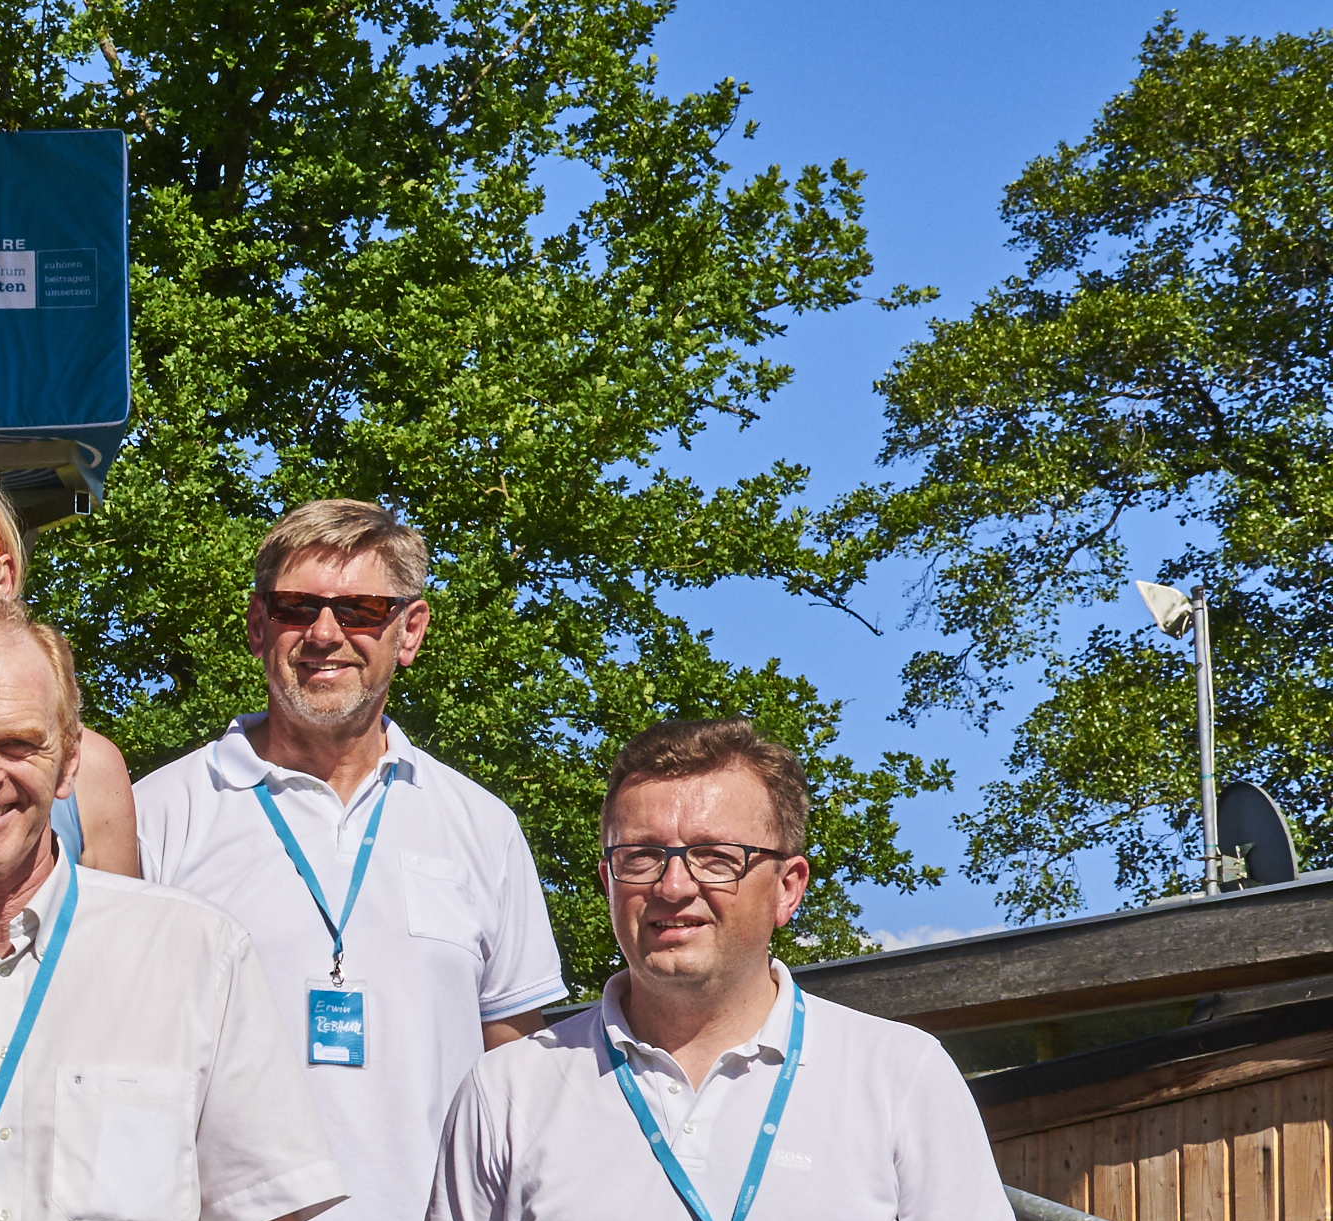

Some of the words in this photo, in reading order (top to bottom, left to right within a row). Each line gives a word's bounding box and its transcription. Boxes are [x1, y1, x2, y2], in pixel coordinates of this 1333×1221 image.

[44, 259, 83, 270] zuhören
[44, 273, 91, 285] beitragen
[44, 288, 92, 297] umsetzen
[314, 1000, 351, 1013] Erwin
[783, 1048, 799, 1081] beitragen
[686, 1189, 706, 1216] zuhören
[741, 1185, 755, 1213] zuhören
